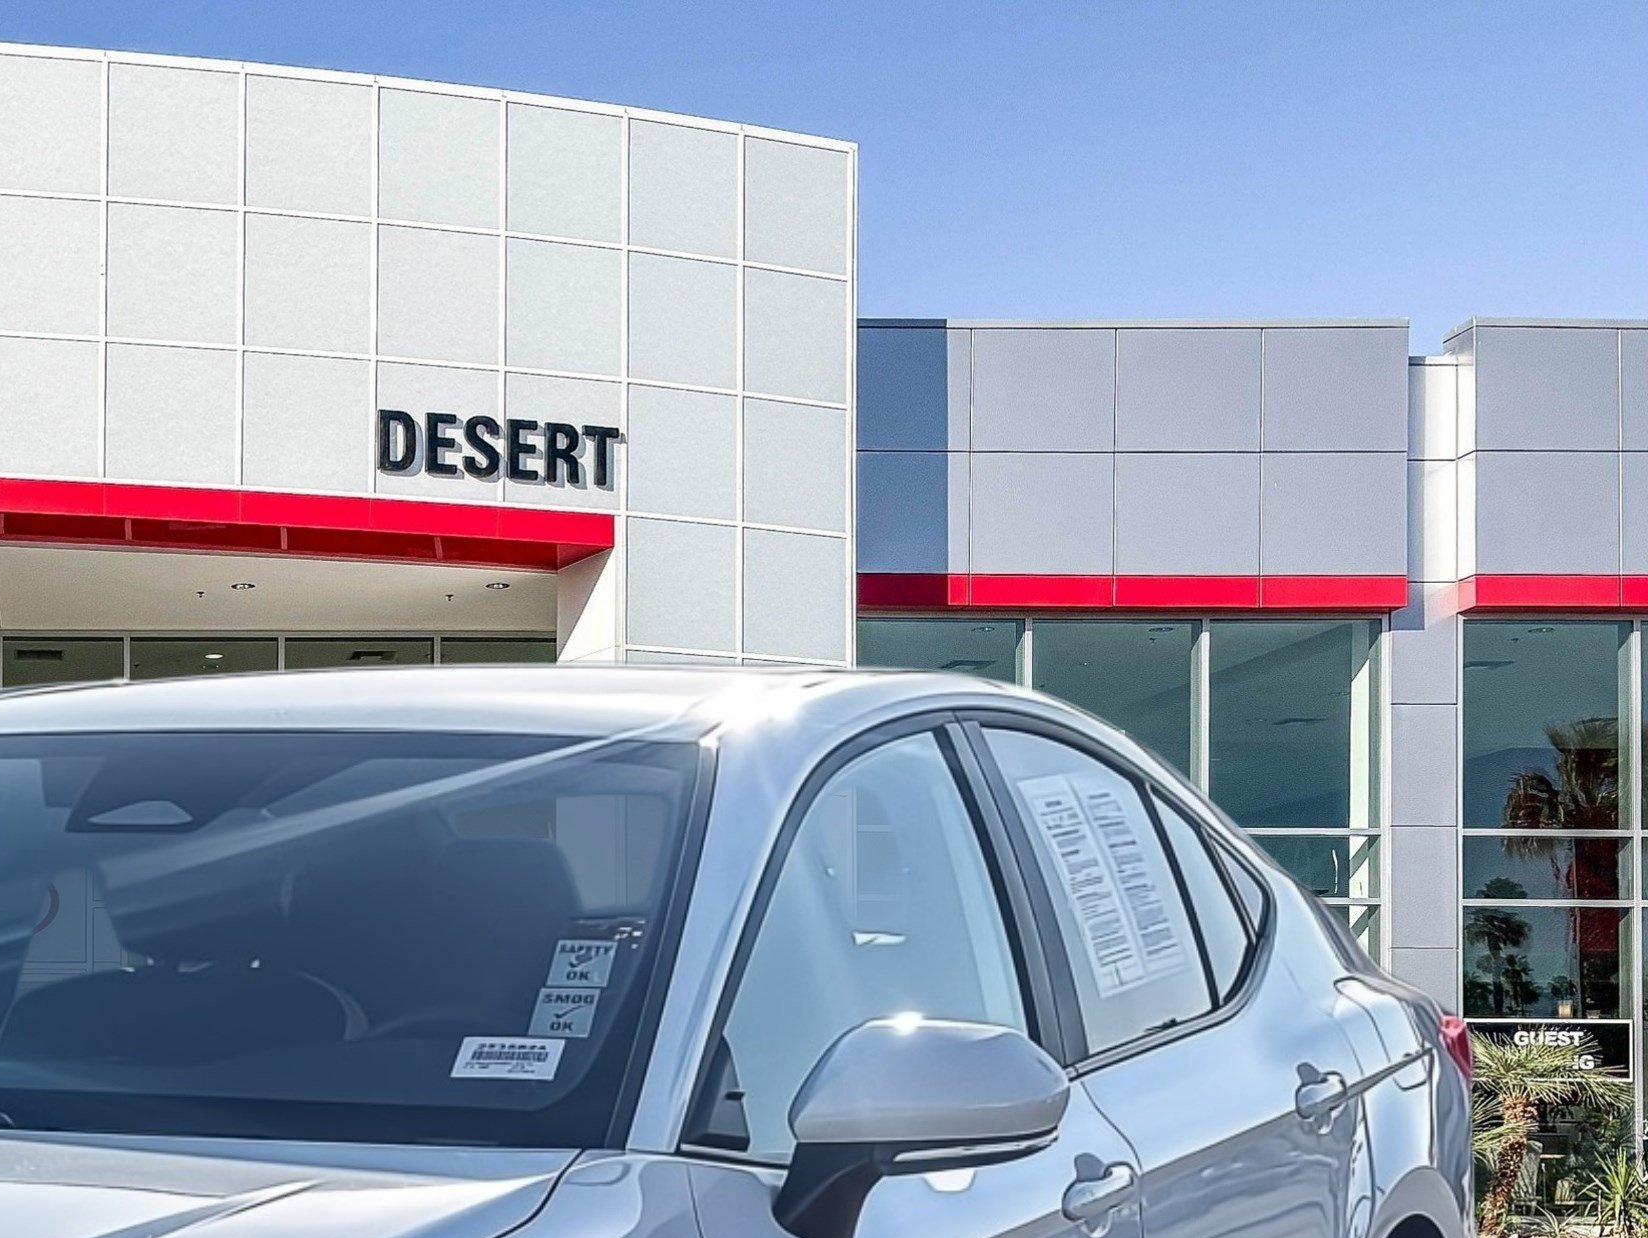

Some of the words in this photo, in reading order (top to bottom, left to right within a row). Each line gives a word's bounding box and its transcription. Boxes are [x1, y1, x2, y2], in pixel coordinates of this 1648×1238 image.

[377, 409, 621, 487] DESERT
[566, 971, 590, 980] OK
[1513, 1031, 1583, 1047] GUEST
